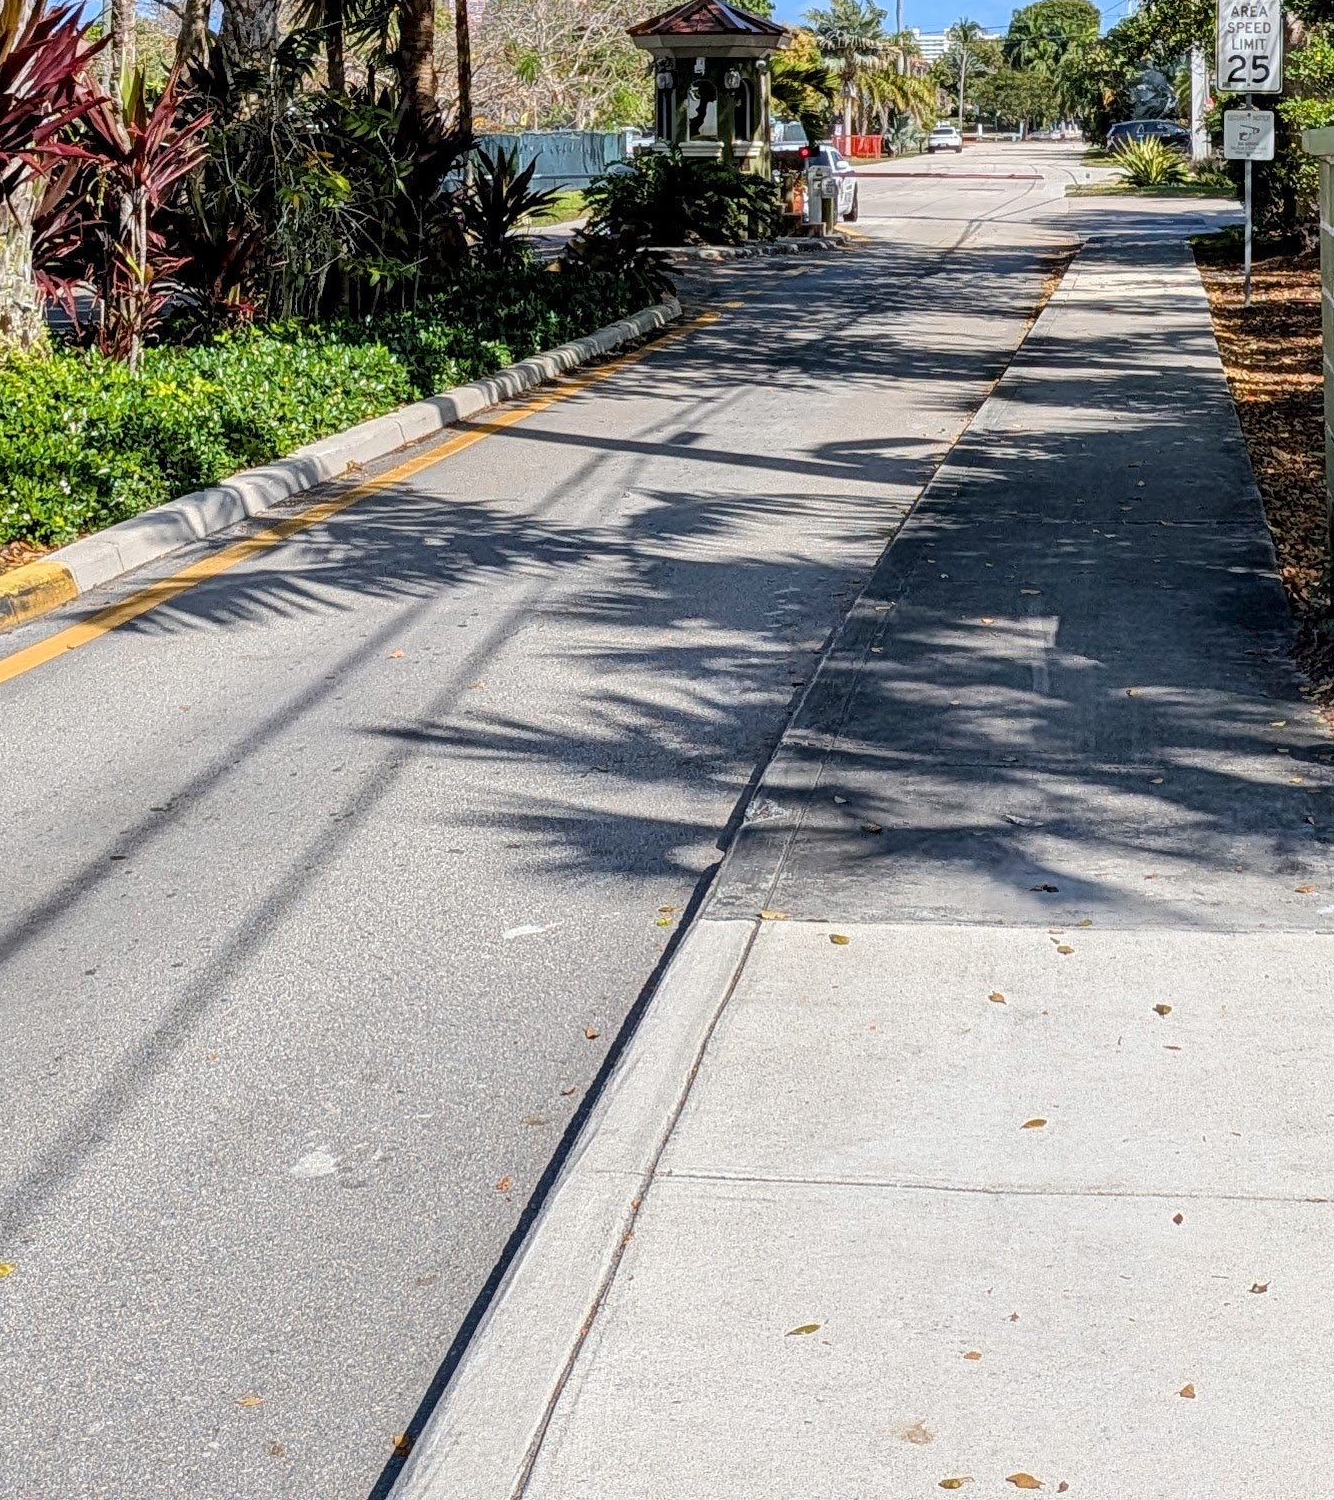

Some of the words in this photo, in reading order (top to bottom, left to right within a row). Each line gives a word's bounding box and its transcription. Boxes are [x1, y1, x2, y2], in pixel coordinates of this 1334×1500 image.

[1230, 5, 1268, 18] AREA
[1227, 21, 1271, 34] SPEED
[1231, 38, 1267, 51] LIMIT
[1227, 54, 1270, 84] 25
